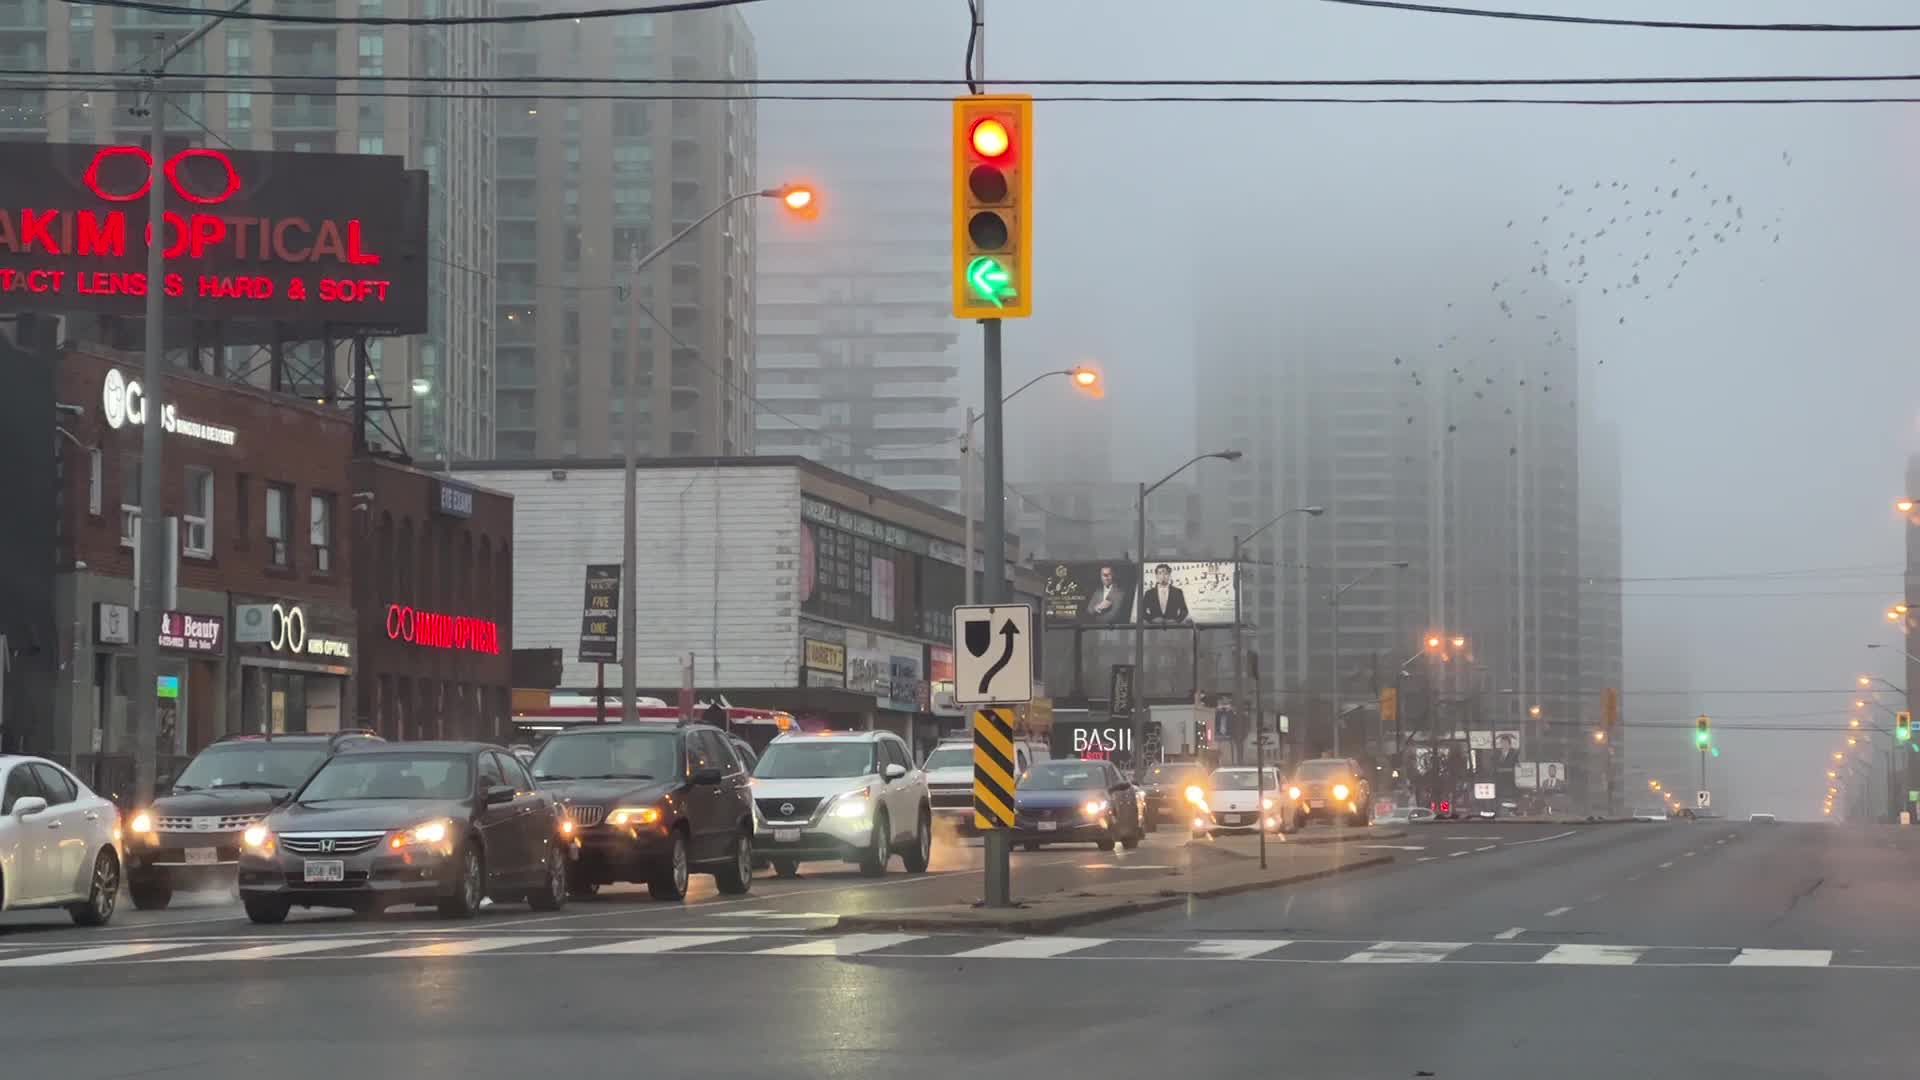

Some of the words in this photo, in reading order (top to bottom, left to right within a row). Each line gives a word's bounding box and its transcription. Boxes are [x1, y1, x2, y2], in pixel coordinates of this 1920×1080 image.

[145, 211, 380, 265] OPTICAL
[77, 271, 183, 298] LENSS
[199, 275, 273, 299] HARD
[287, 278, 306, 302] &
[319, 279, 390, 303] SOFT
[184, 615, 220, 645] Beauty
[415, 611, 453, 649] HAKIM
[455, 615, 499, 656] OPTICAL
